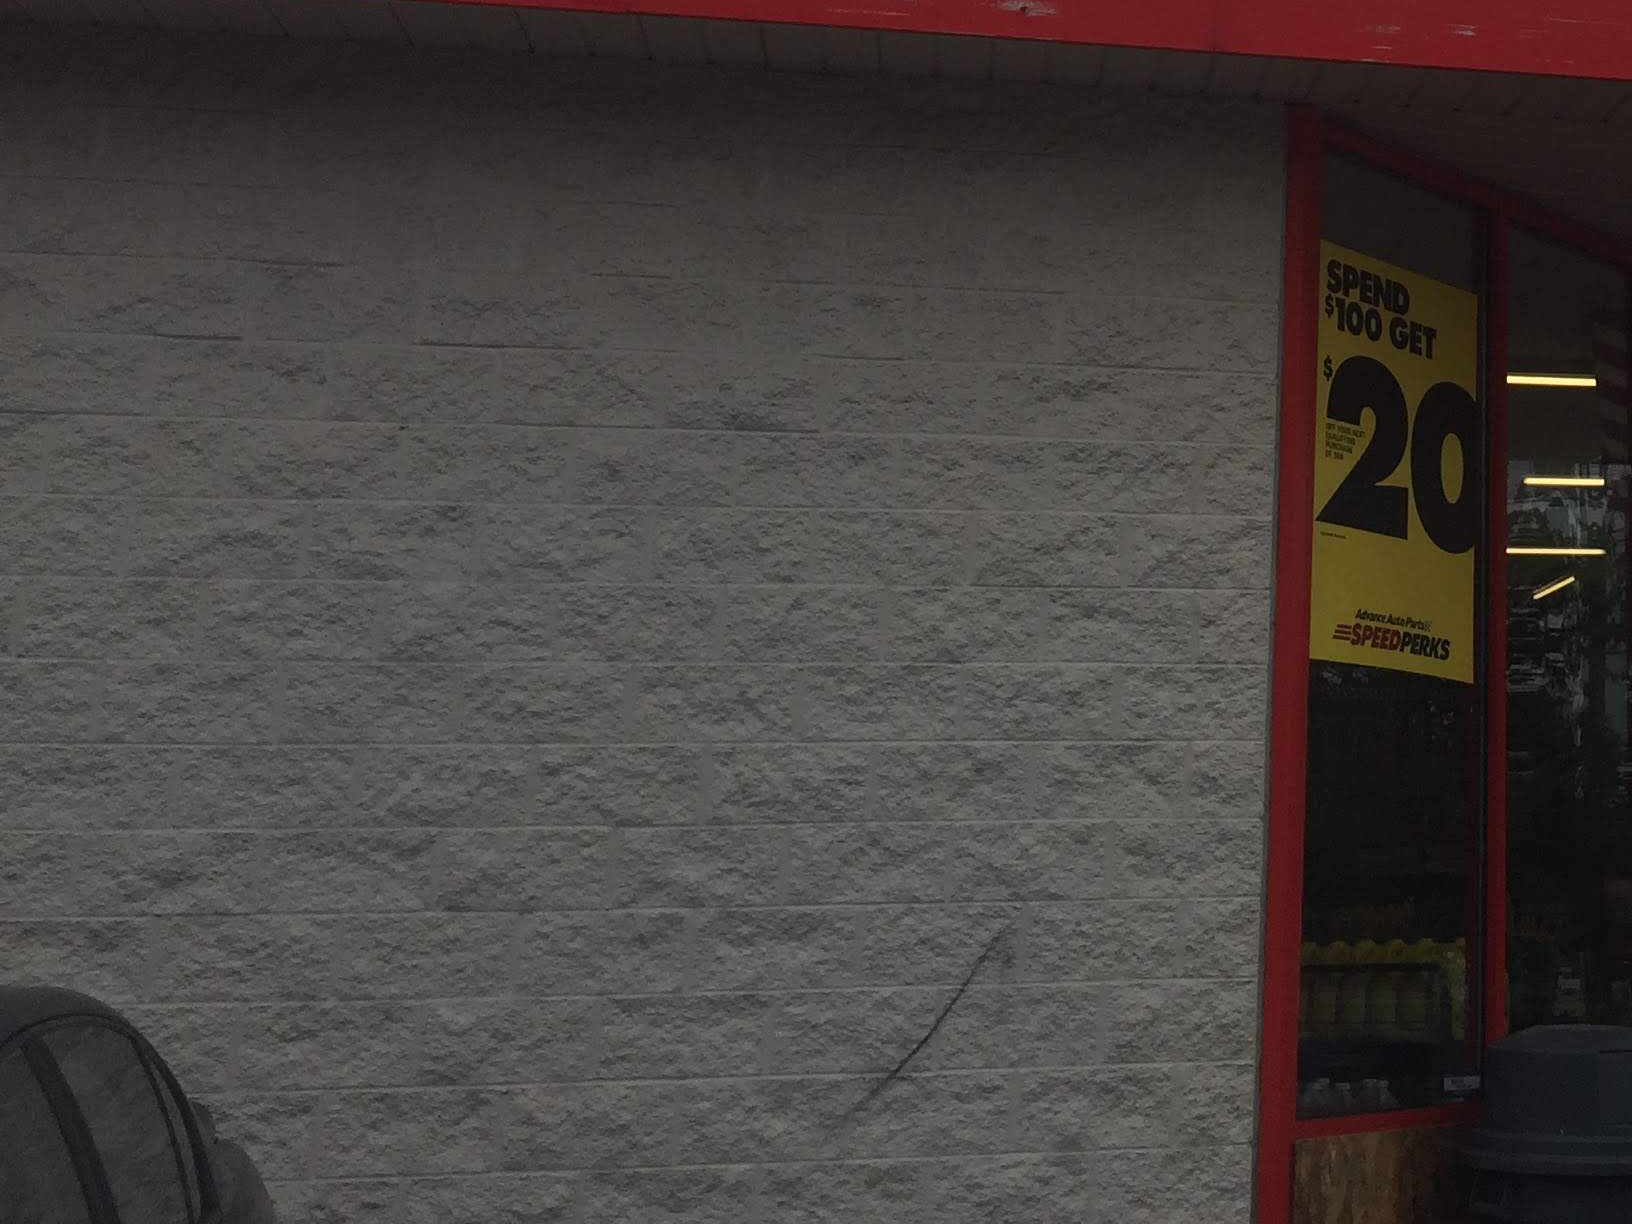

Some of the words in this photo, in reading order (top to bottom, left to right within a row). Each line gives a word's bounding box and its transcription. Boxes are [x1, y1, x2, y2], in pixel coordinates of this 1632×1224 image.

[1326, 259, 1410, 316] SPEND
[1325, 293, 1383, 342] $100
[1389, 316, 1437, 359] GET
[1386, 613, 1406, 627] Auto
